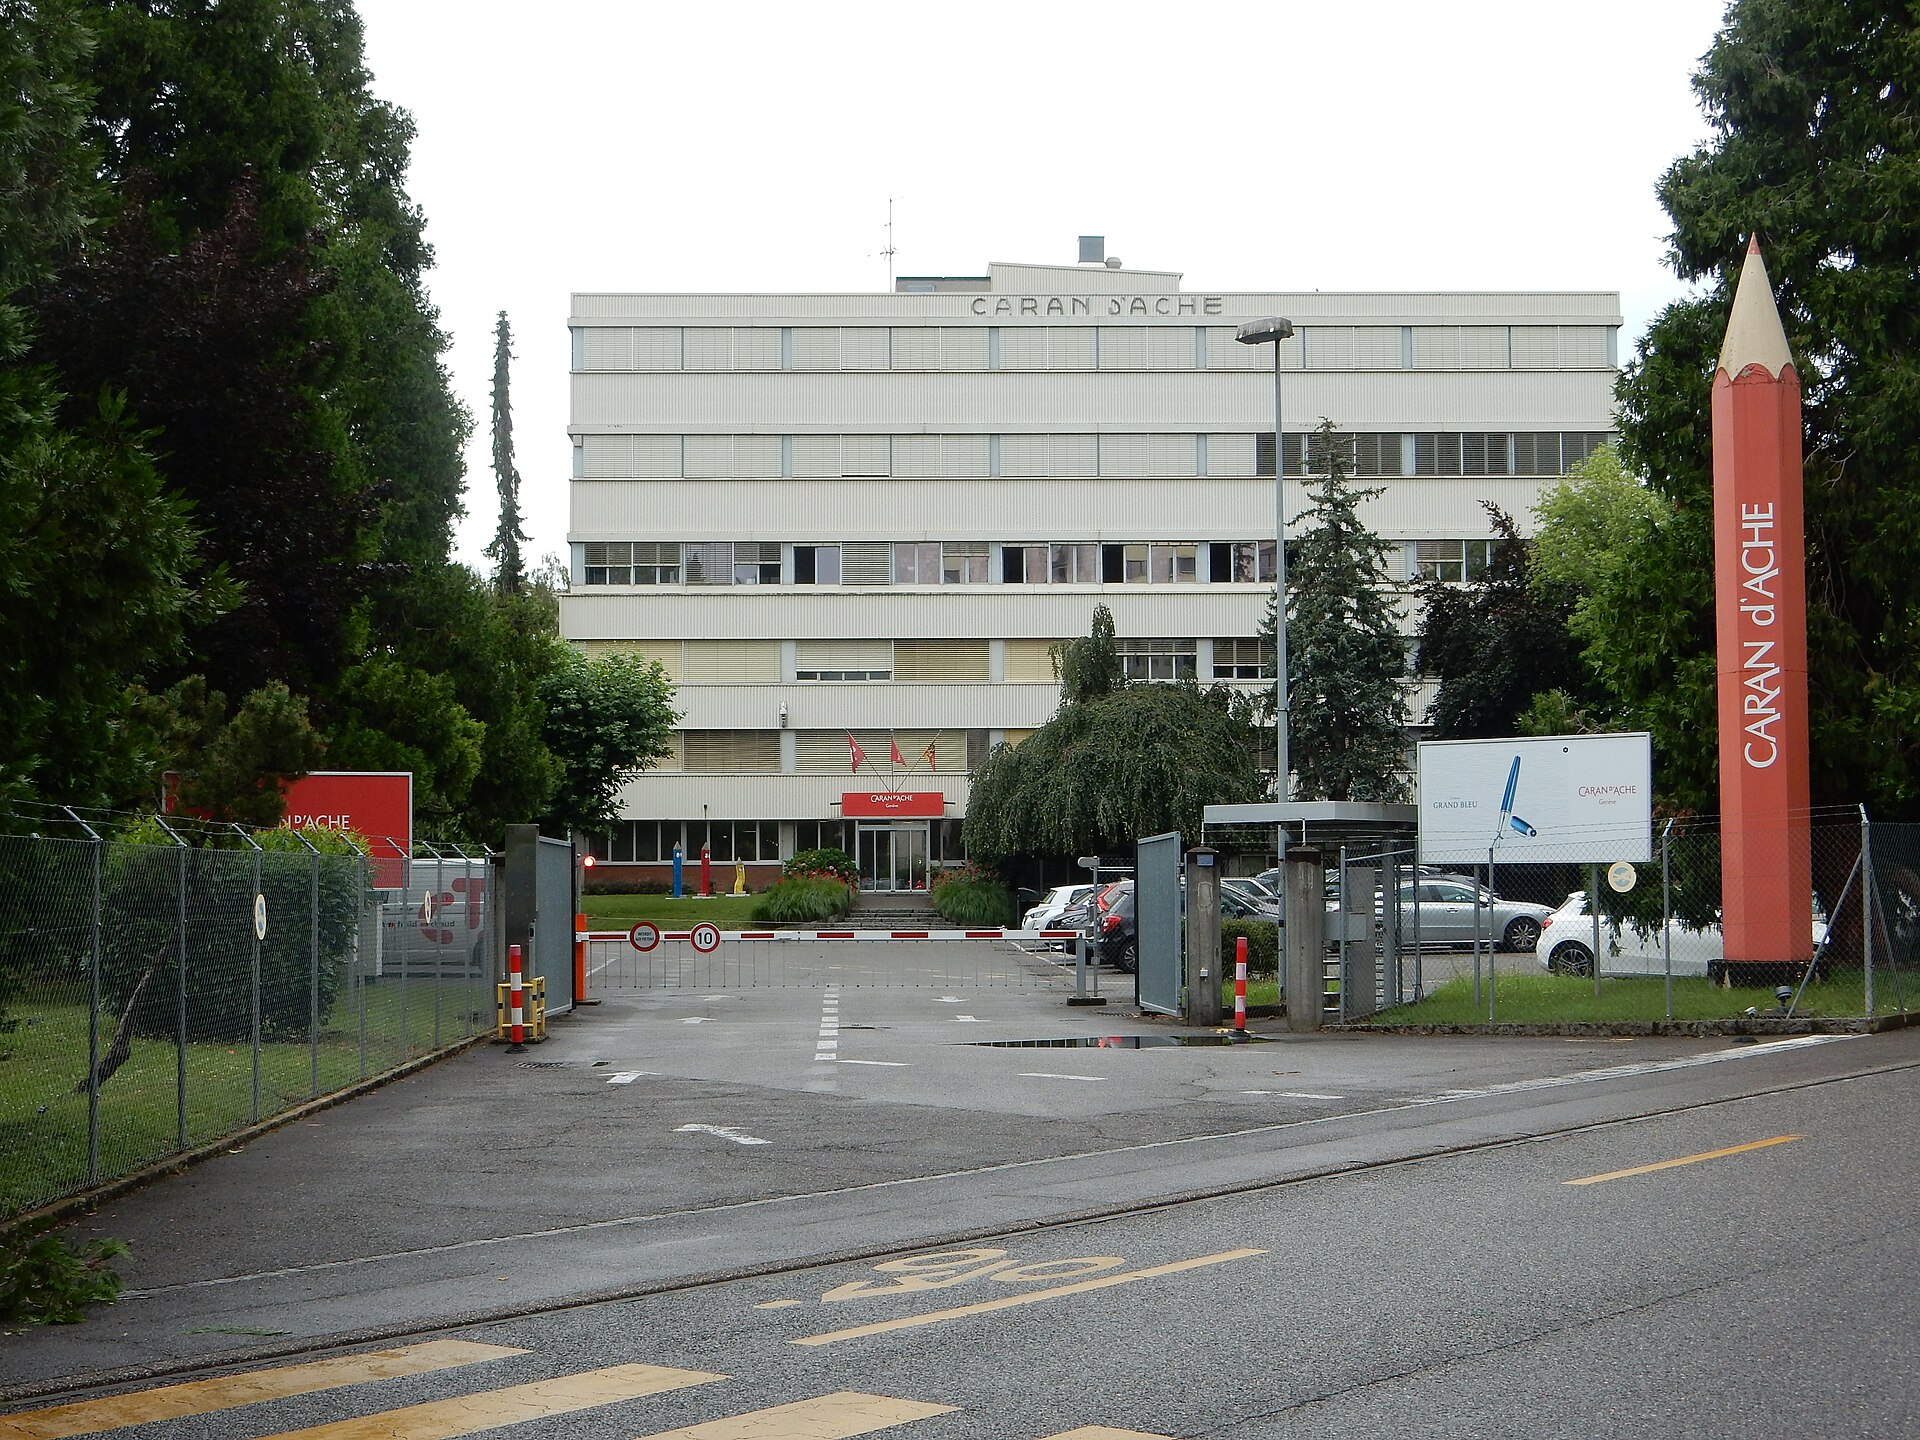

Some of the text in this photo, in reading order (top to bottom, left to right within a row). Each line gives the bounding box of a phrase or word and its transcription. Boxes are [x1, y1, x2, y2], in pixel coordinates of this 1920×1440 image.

[971, 297, 1090, 316] CARAN
[1739, 502, 1781, 769] CARAN d'ACHE
[1432, 800, 1478, 809] GRAND BLEU
[697, 932, 713, 945] 10
